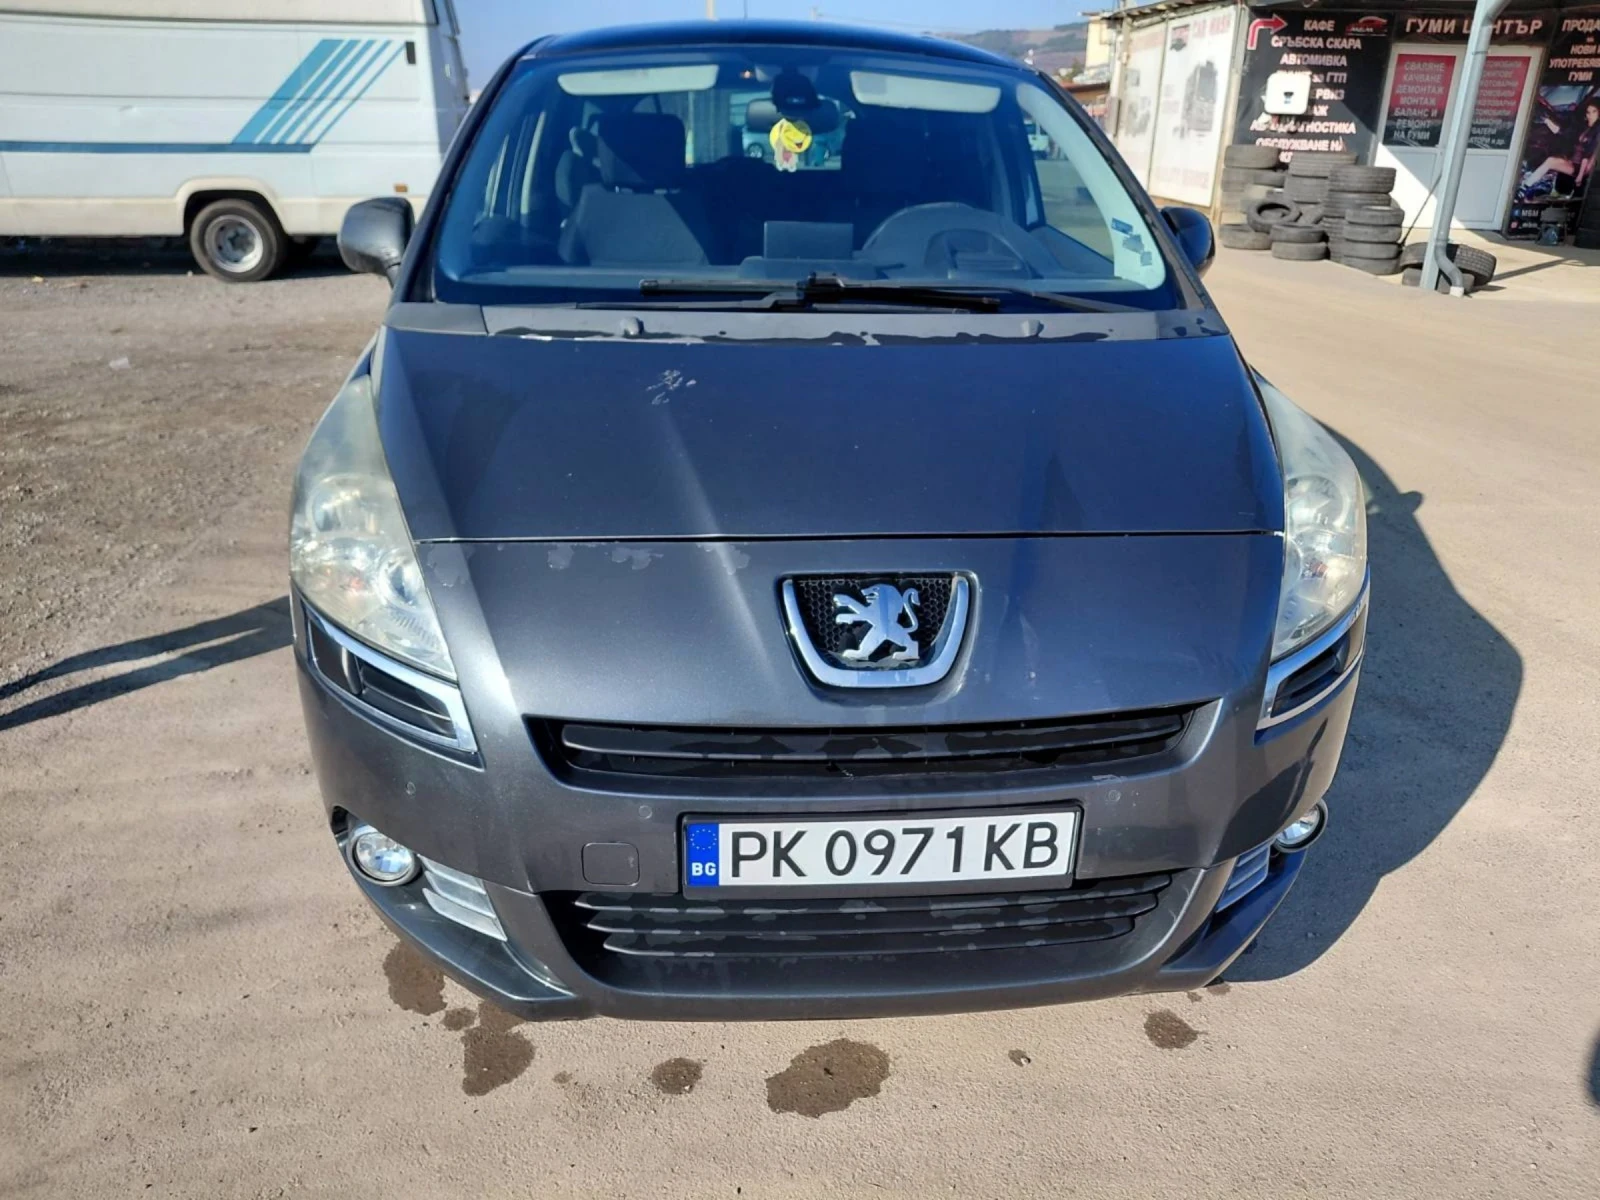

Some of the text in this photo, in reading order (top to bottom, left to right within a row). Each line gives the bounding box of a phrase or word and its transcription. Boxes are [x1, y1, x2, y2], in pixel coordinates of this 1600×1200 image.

[1304, 20, 1335, 31] КАФЕ
[1405, 18, 1543, 35] ГУМИ ЦНТЪР
[1271, 36, 1361, 50] СРЪБСКА СКАРА
[1570, 45, 1596, 55] НОВИ
[1280, 53, 1347, 66] АВТОМИВКА
[1326, 72, 1347, 83] ГТП
[1568, 71, 1593, 82] ГУМИ
[1396, 85, 1444, 95] ДЕМОНТАЖ
[1400, 97, 1436, 105] МОНТАЖ
[1394, 107, 1438, 117] БАЛАНС И
[1396, 119, 1431, 129] РЕМОНТ
[1394, 130, 1431, 140] НА ГУМИ
[825, 825, 963, 877] 0971
[691, 862, 716, 876] BG
